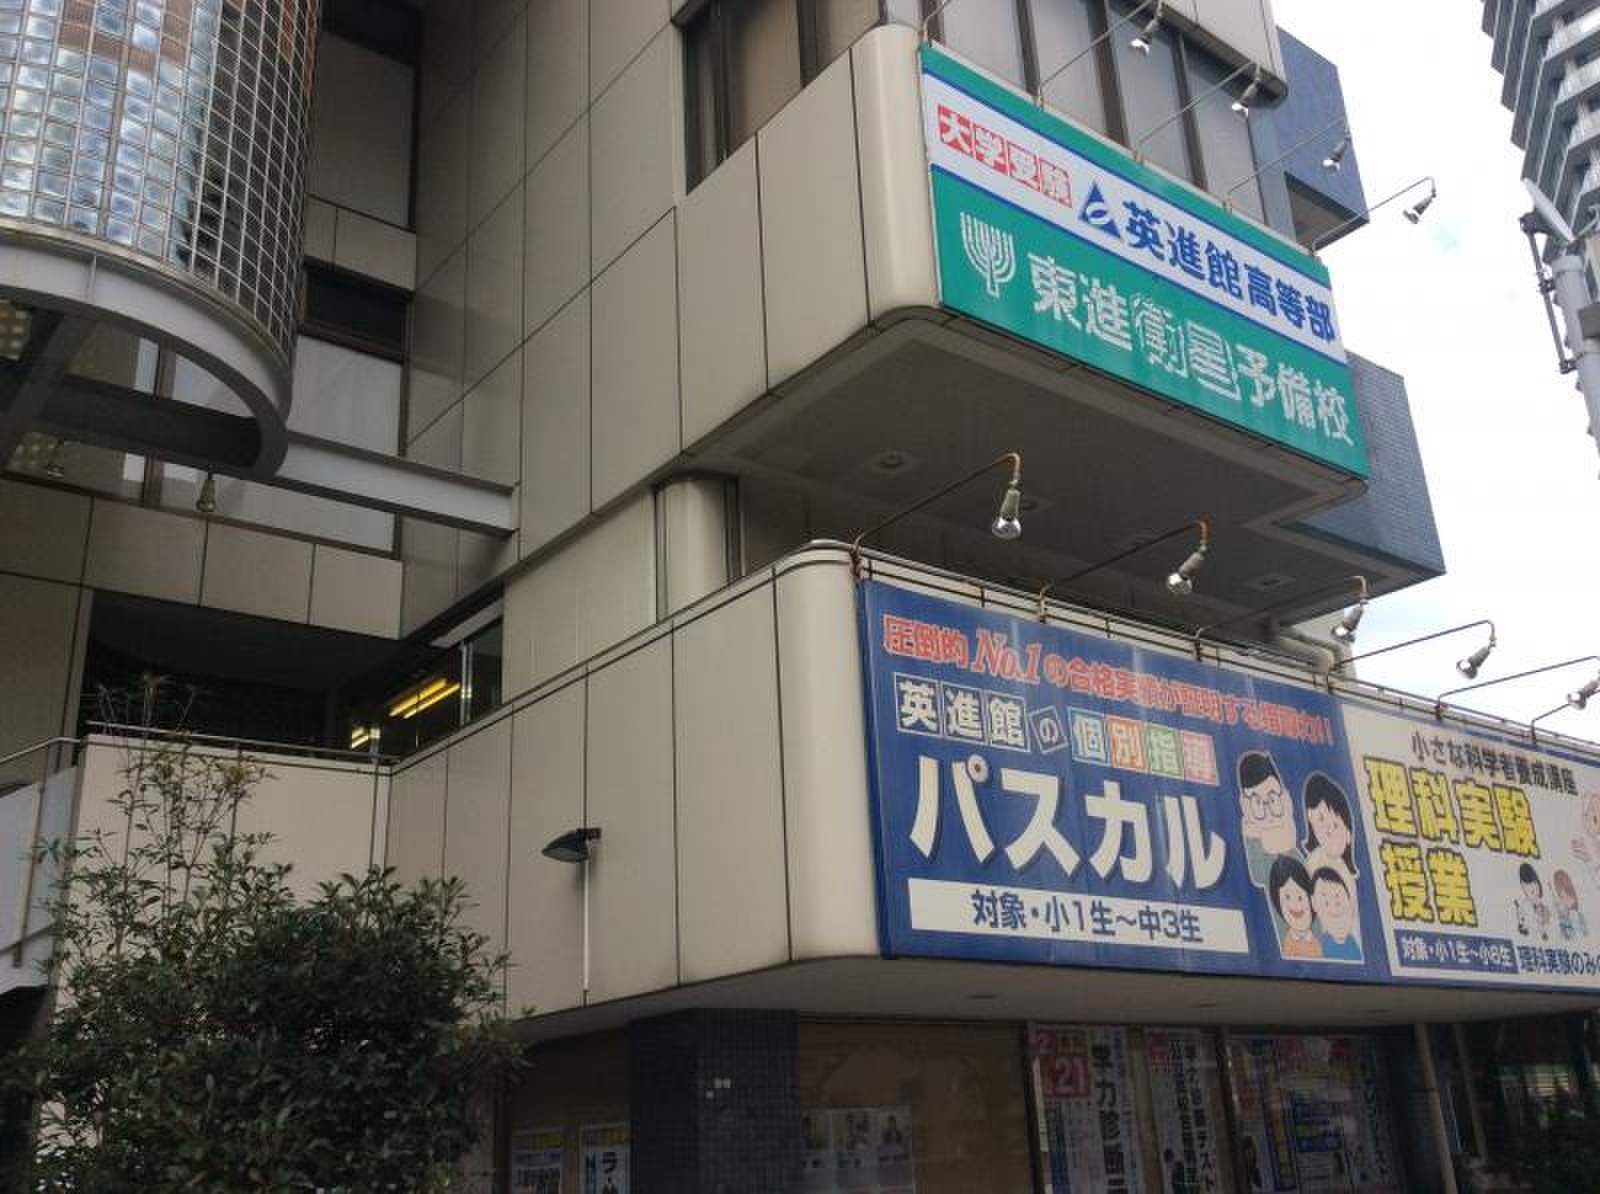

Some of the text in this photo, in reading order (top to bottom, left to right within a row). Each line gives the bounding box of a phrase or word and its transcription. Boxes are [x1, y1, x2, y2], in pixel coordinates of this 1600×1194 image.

[1121, 200, 1335, 342] 英進館高等部
[1028, 252, 1354, 446] 東進衛星予備校
[909, 752, 1226, 890] パスカル
[1363, 755, 1540, 858] 理科実験
[1380, 838, 1478, 926] 授業
